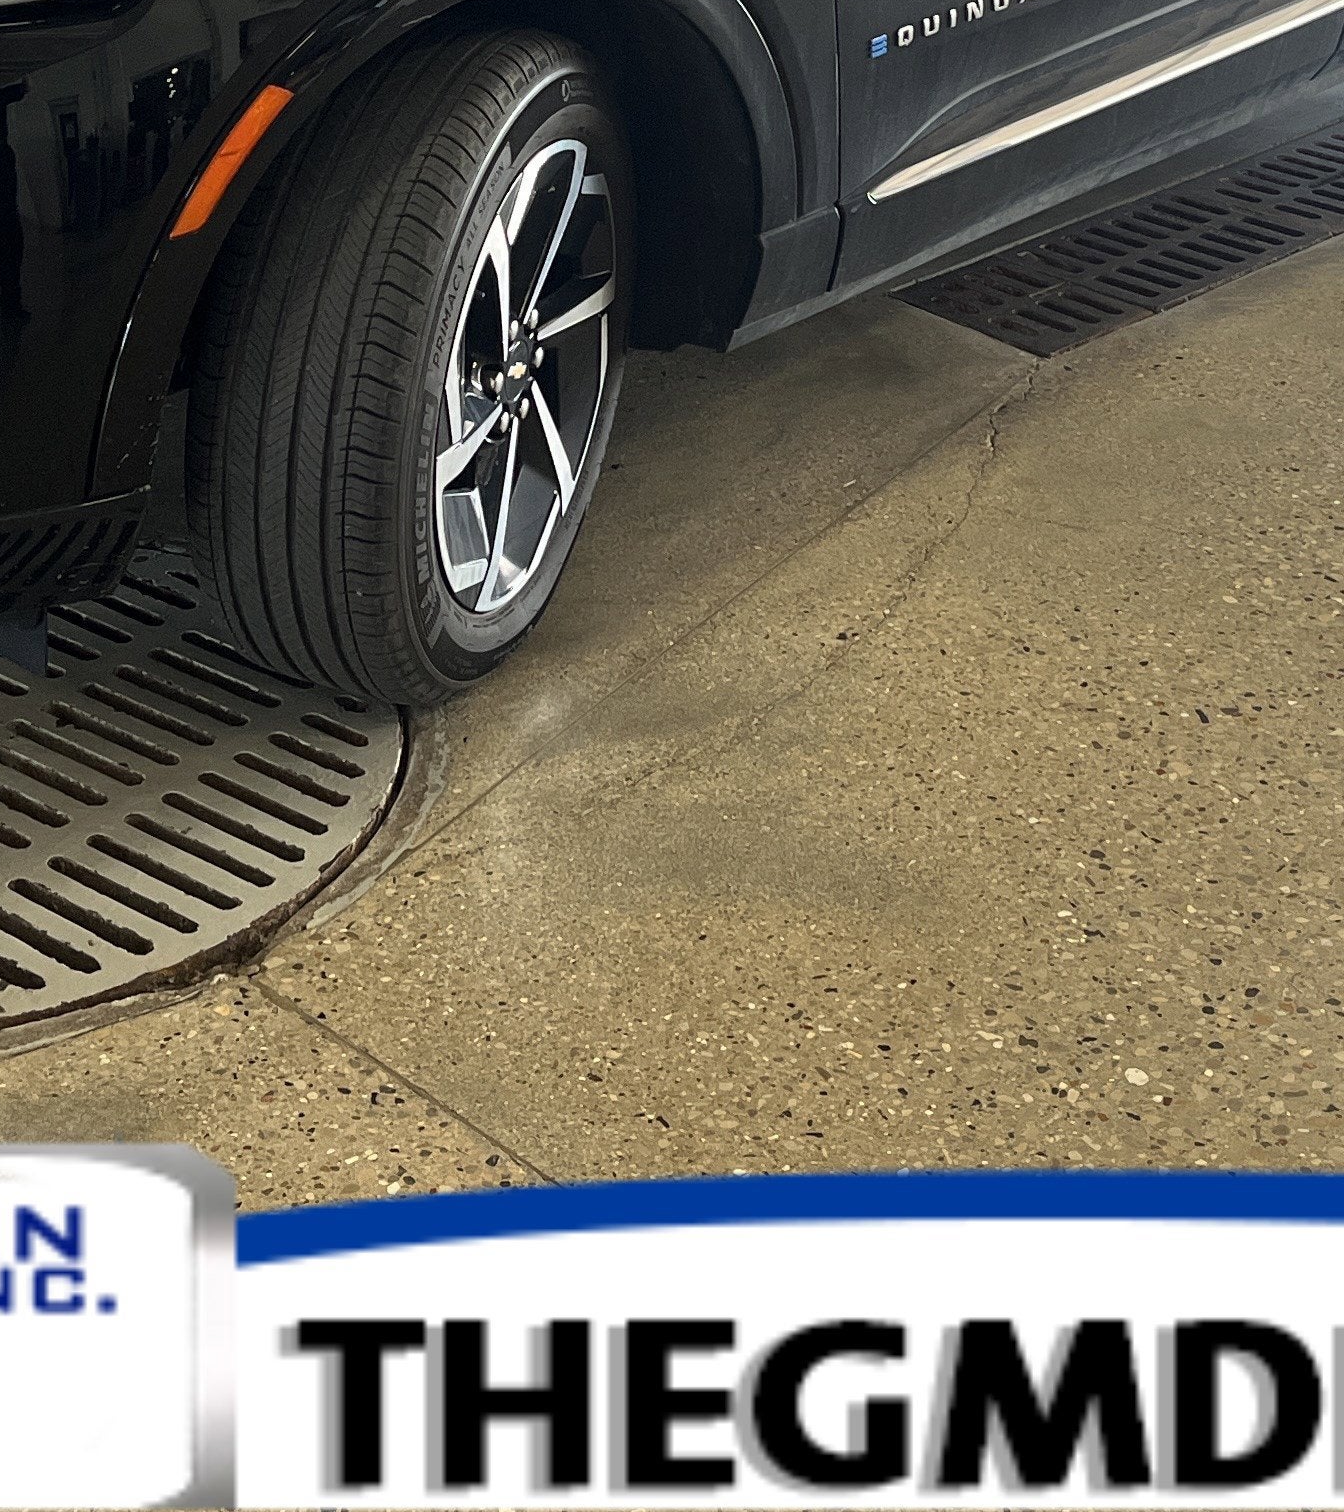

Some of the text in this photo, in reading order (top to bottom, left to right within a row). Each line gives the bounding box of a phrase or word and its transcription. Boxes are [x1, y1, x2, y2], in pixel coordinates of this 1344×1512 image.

[431, 160, 506, 369] PRIMACY ALL SEASON
[414, 402, 435, 586] MICHELIN
